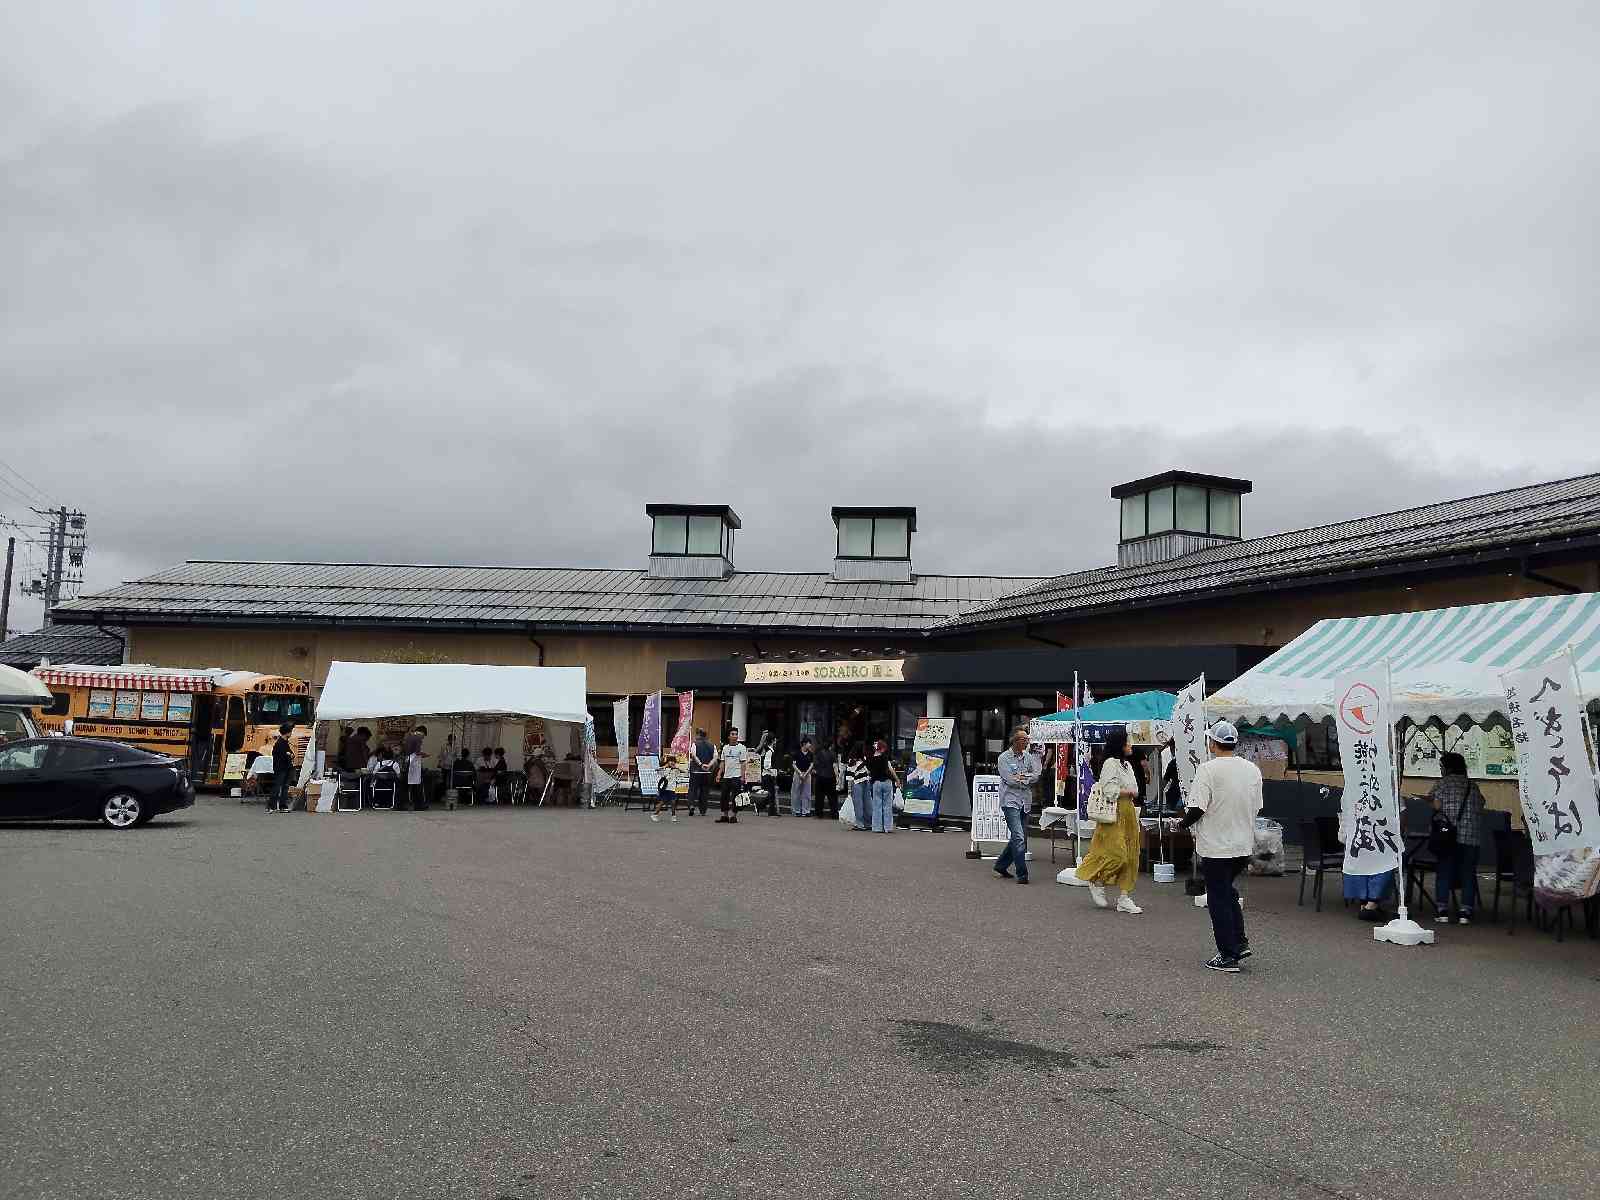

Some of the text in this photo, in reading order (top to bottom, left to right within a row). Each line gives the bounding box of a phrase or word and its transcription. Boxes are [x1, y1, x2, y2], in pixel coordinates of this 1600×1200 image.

[814, 665, 868, 678] SORAIRO
[128, 727, 150, 736] SCHOOL
[153, 728, 179, 737] DISTRICT
